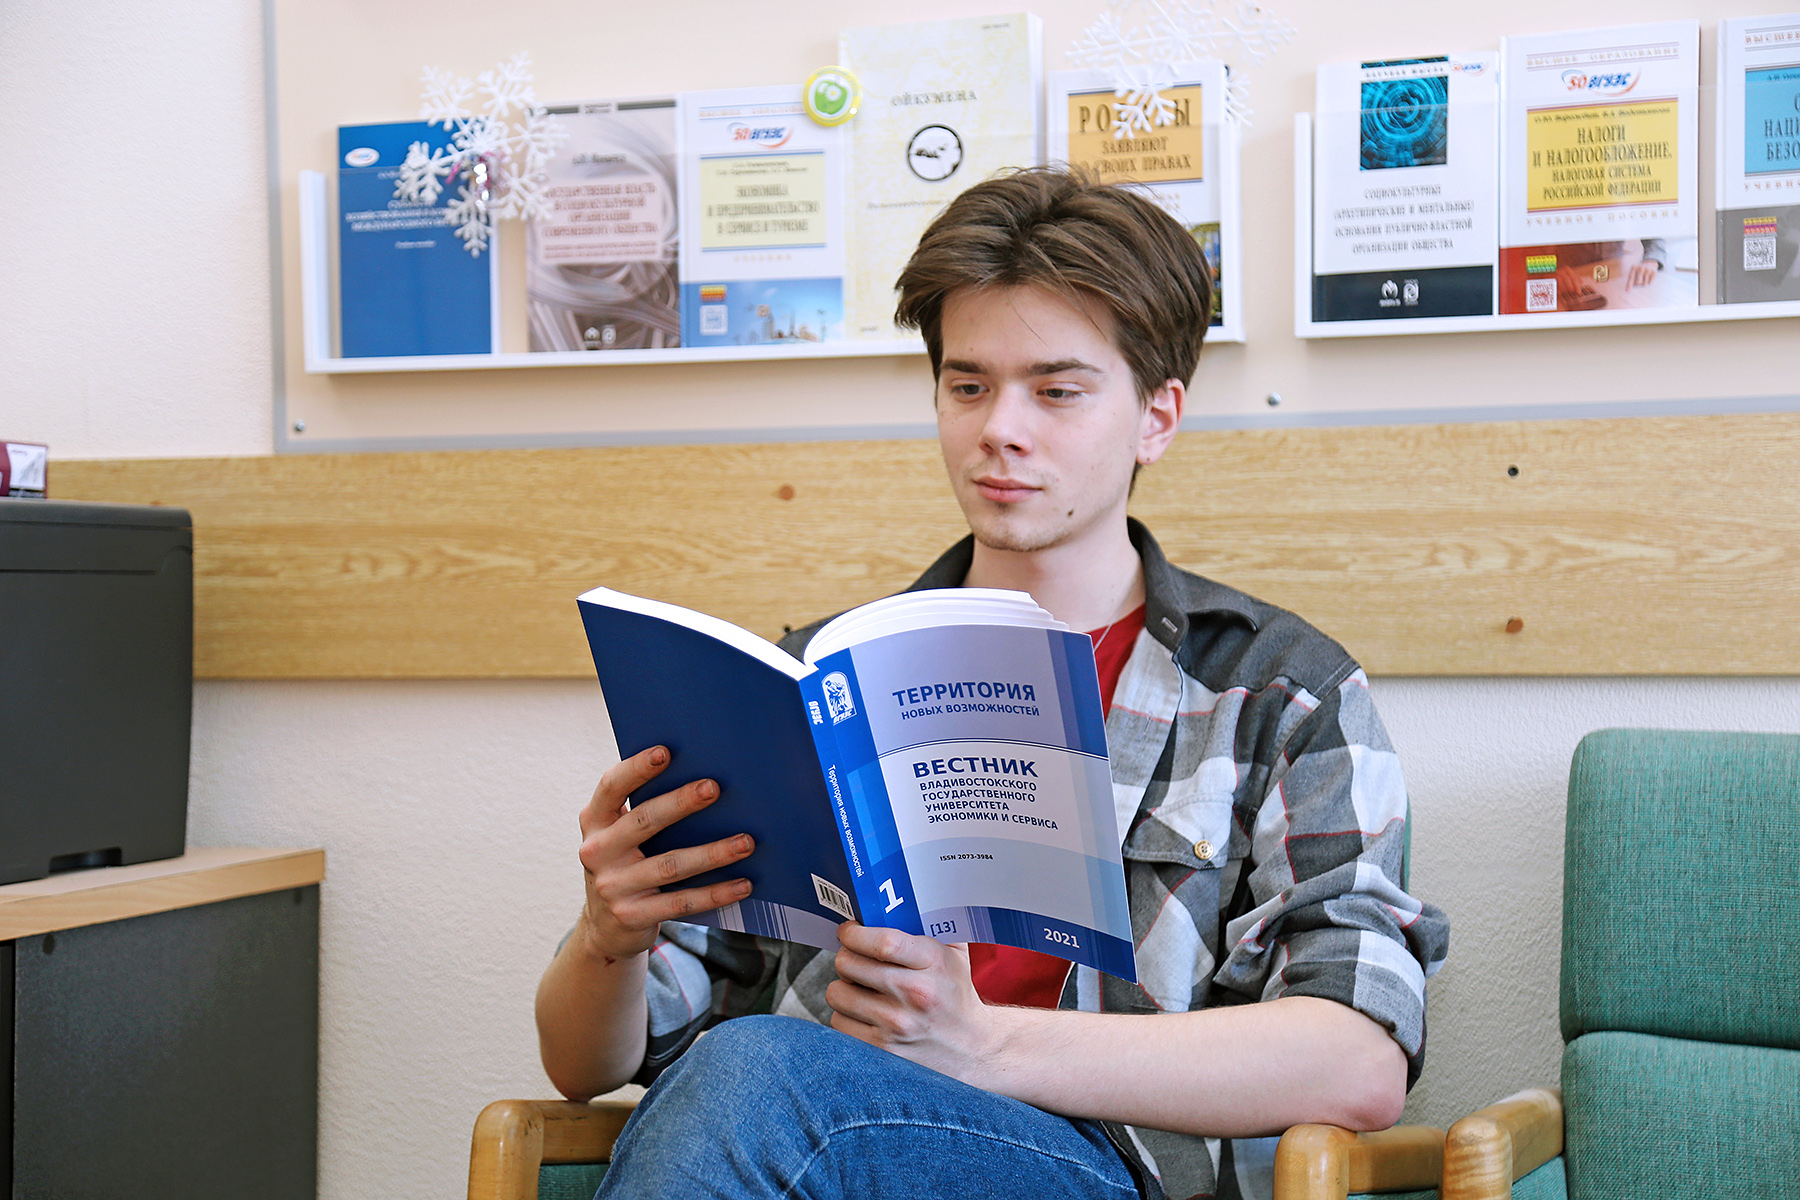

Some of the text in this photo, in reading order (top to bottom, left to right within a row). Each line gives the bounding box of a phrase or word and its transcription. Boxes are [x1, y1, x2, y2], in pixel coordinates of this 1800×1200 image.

[1567, 75, 1587, 91] 50
[891, 90, 977, 106] ОЙКУМЕНА
[1079, 98, 1191, 132] РОЫ
[1577, 124, 1626, 144] НАЛОГИ
[1102, 136, 1168, 154] ЗАЯВЛЯЮТ
[1142, 154, 1191, 170] ПРАВАХ
[1532, 151, 1541, 168] И
[1552, 163, 1652, 183] НАЛОГОВАЯ СИСТЕМА
[1543, 179, 1661, 200] РОССИЙСКОЙ ФЕДЕРАЦИИ
[892, 681, 1036, 707] ТЕРРИТОРИЯ
[901, 703, 1040, 720] НОВЫХ ВОЗМОЖНОСТЕЙ
[912, 757, 1038, 778] ВЕСТНИК
[828, 764, 844, 808] Территория
[919, 777, 1037, 791] ВЛАДИВОСТОКСКОГО
[922, 789, 1036, 803] ГОСУДАРСТВЕННОГО
[925, 800, 1010, 813] УНИВЕРСИТЕТА
[927, 812, 1058, 830] ЭКОНОМИКИ И СЕРВИСА
[878, 878, 905, 914] 1
[930, 920, 957, 937] [13]
[1043, 927, 1080, 949] 2021
